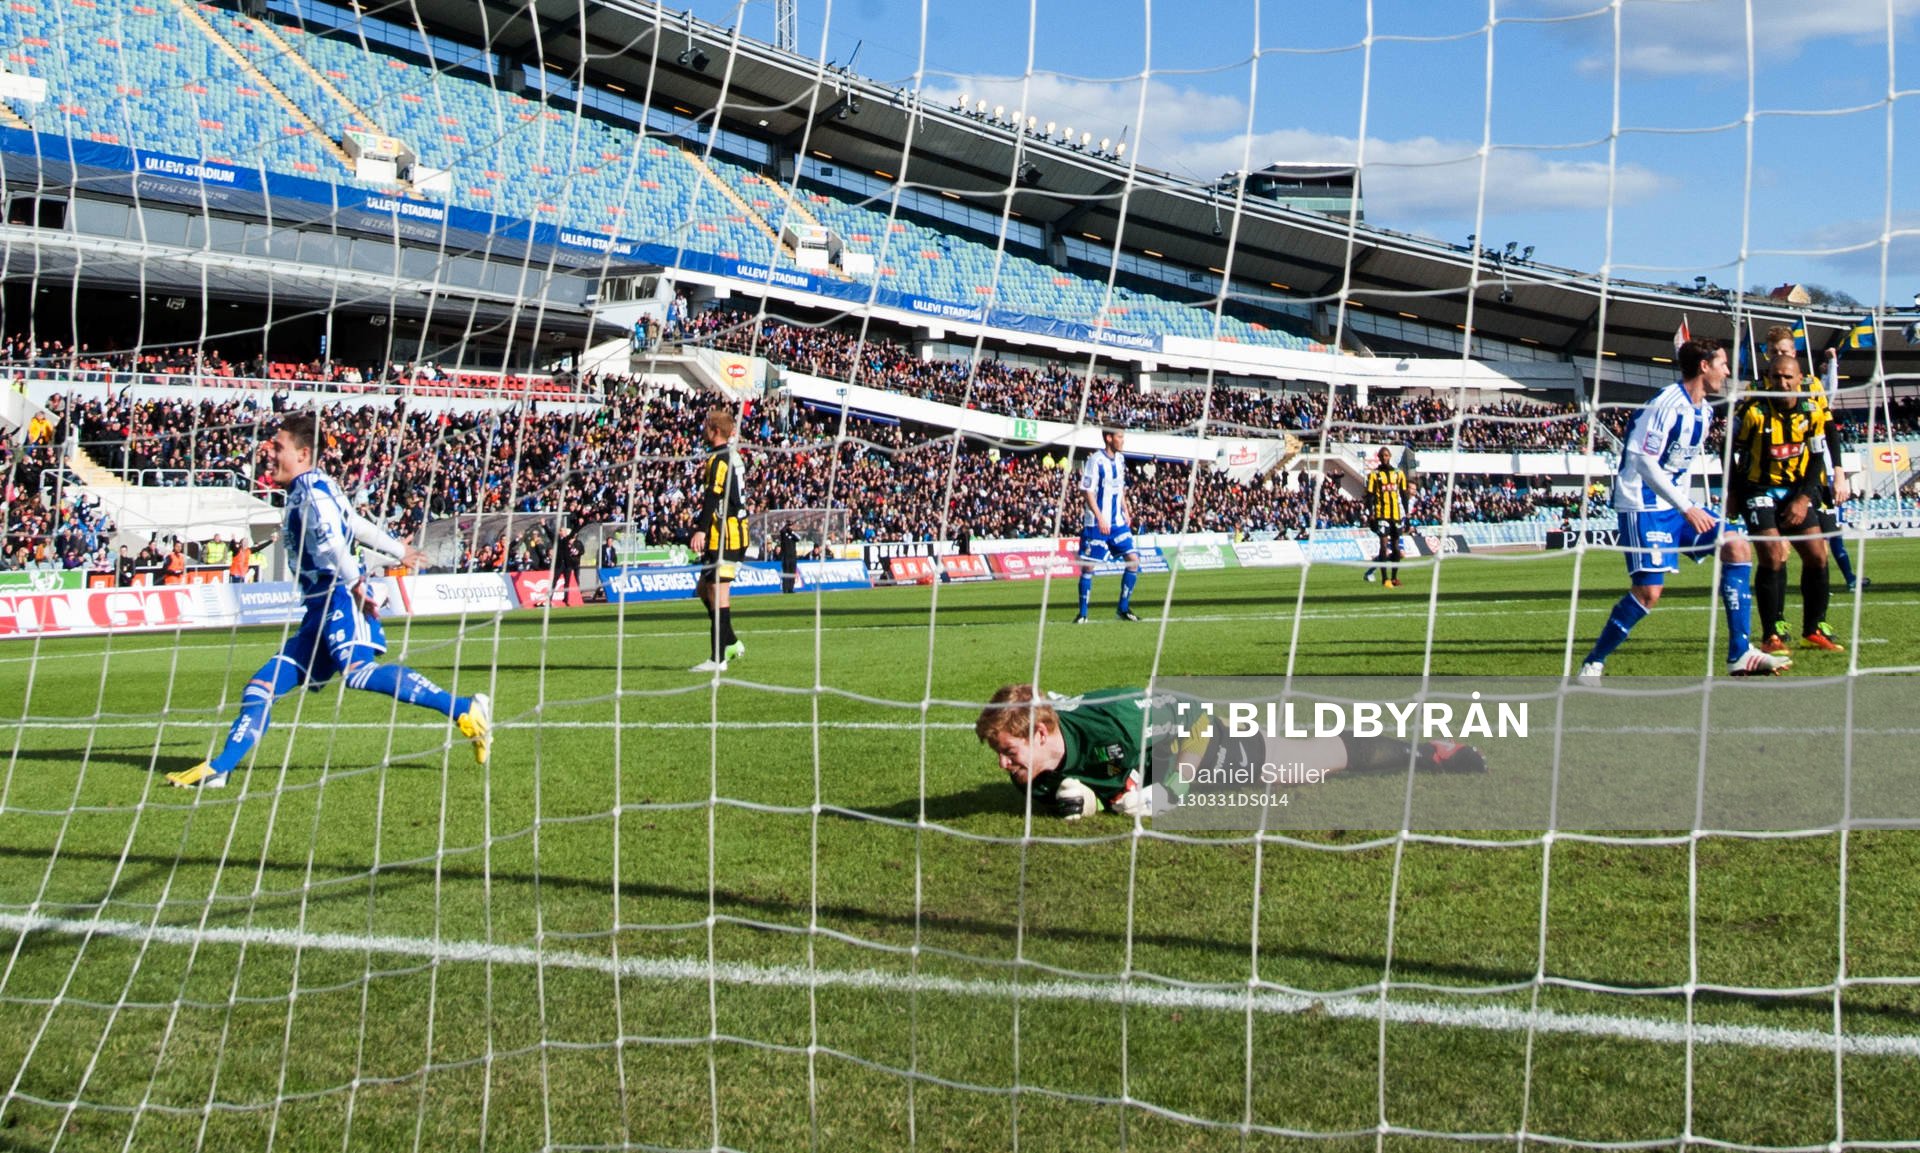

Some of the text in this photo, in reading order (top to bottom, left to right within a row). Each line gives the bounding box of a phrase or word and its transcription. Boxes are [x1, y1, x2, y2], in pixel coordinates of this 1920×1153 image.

[145, 157, 235, 183] ULLEVI STADIUM
[367, 196, 444, 220] ULLEVI STADIUM
[561, 232, 591, 248] ULLEVI
[737, 264, 808, 288] ULLEVI STADIUM
[913, 299, 982, 321] ULLEVI STADIUM
[893, 562, 932, 576] BRA
[946, 558, 985, 573] BRA
[643, 572, 698, 592] SVERIGES
[436, 584, 508, 603] Shopping
[88, 588, 194, 628] GT
